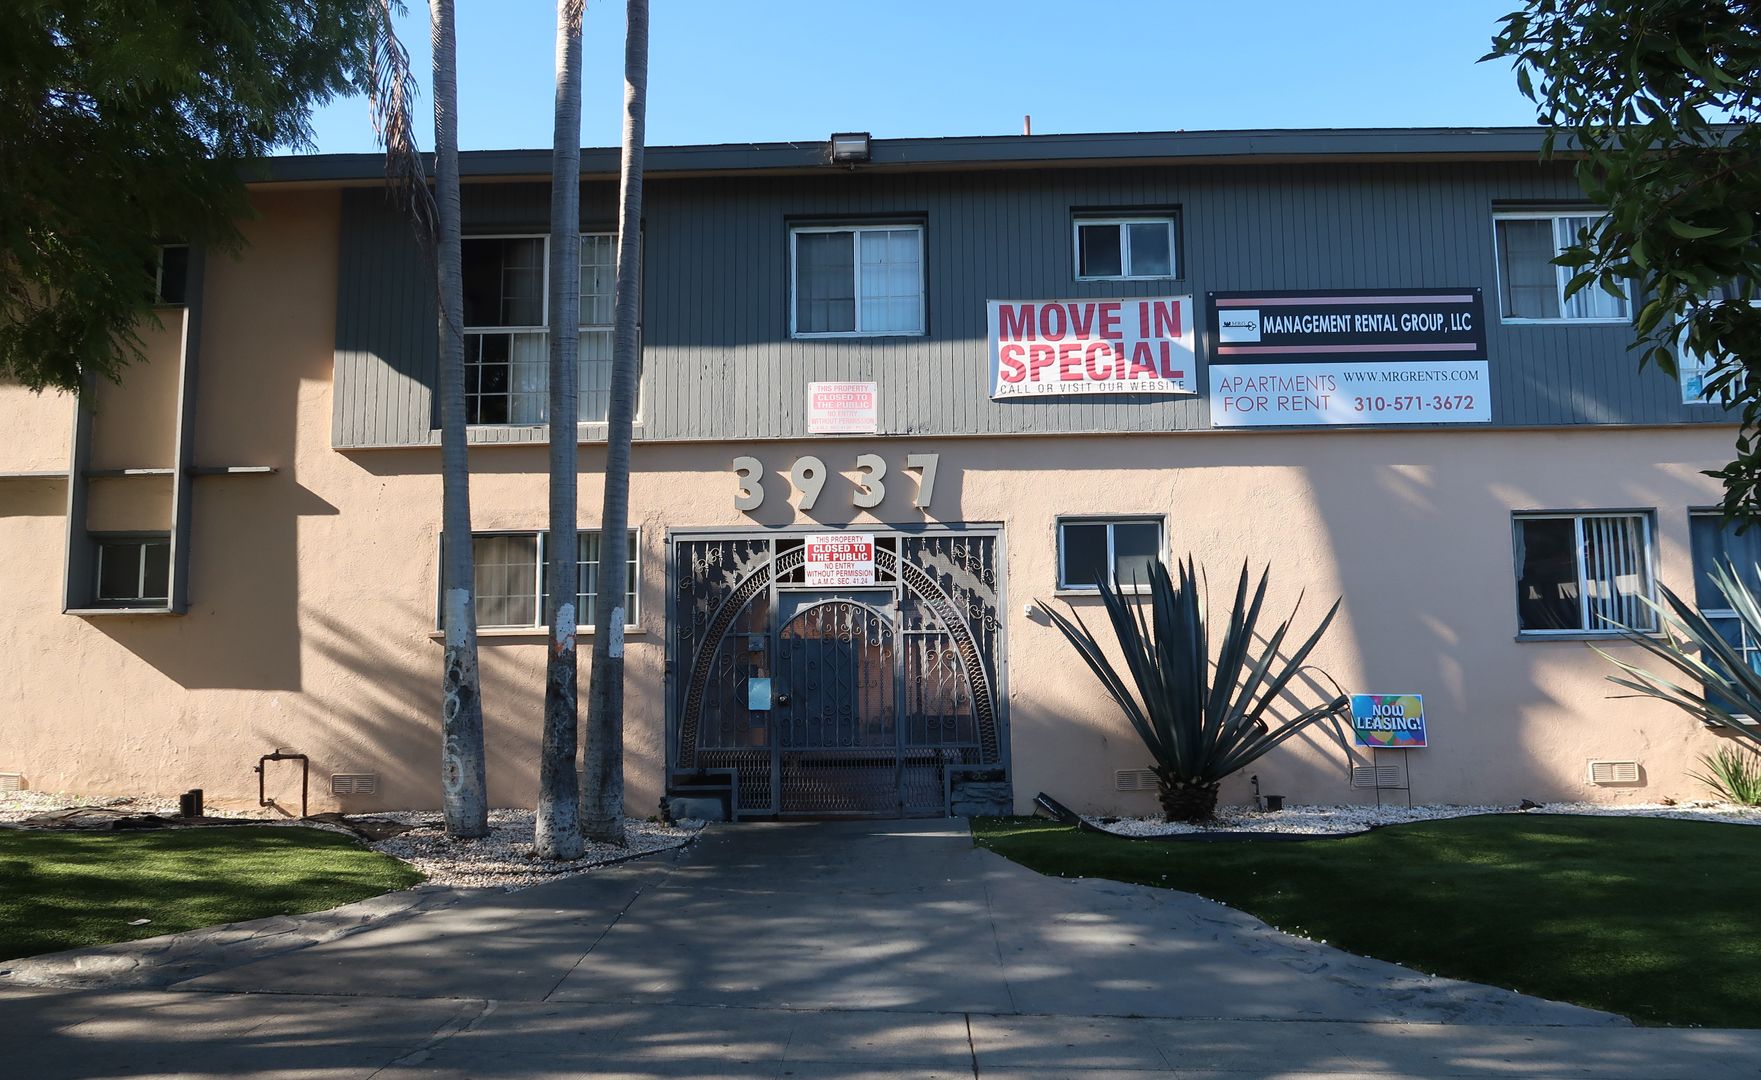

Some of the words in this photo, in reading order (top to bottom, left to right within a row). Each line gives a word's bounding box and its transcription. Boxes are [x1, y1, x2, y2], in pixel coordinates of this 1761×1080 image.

[998, 303, 1123, 342] MOVE
[1138, 300, 1182, 339] IN
[1263, 314, 1351, 334] MANAGEMENT
[1355, 314, 1398, 332] RENTAL
[1400, 313, 1448, 333] GROUP,
[1451, 312, 1472, 331] LLC
[1000, 341, 1184, 383] SPECIAL
[1219, 375, 1336, 393] APARTMENTS
[1343, 370, 1479, 382] WWW.MRGRENTS.COM
[1000, 384, 1031, 394] CALL
[1037, 383, 1053, 393] OR
[1059, 382, 1092, 392] VISIT
[1099, 382, 1123, 392] OUR
[1130, 380, 1185, 391] WEBSITE
[1224, 396, 1268, 412] FOR
[1278, 395, 1330, 411] RENT
[1354, 395, 1474, 412] 310-571-3672
[733, 453, 939, 511] 3937
[813, 544, 850, 552] CLOSED
[1372, 704, 1404, 716] NOW
[1357, 717, 1422, 730] LEASING!
